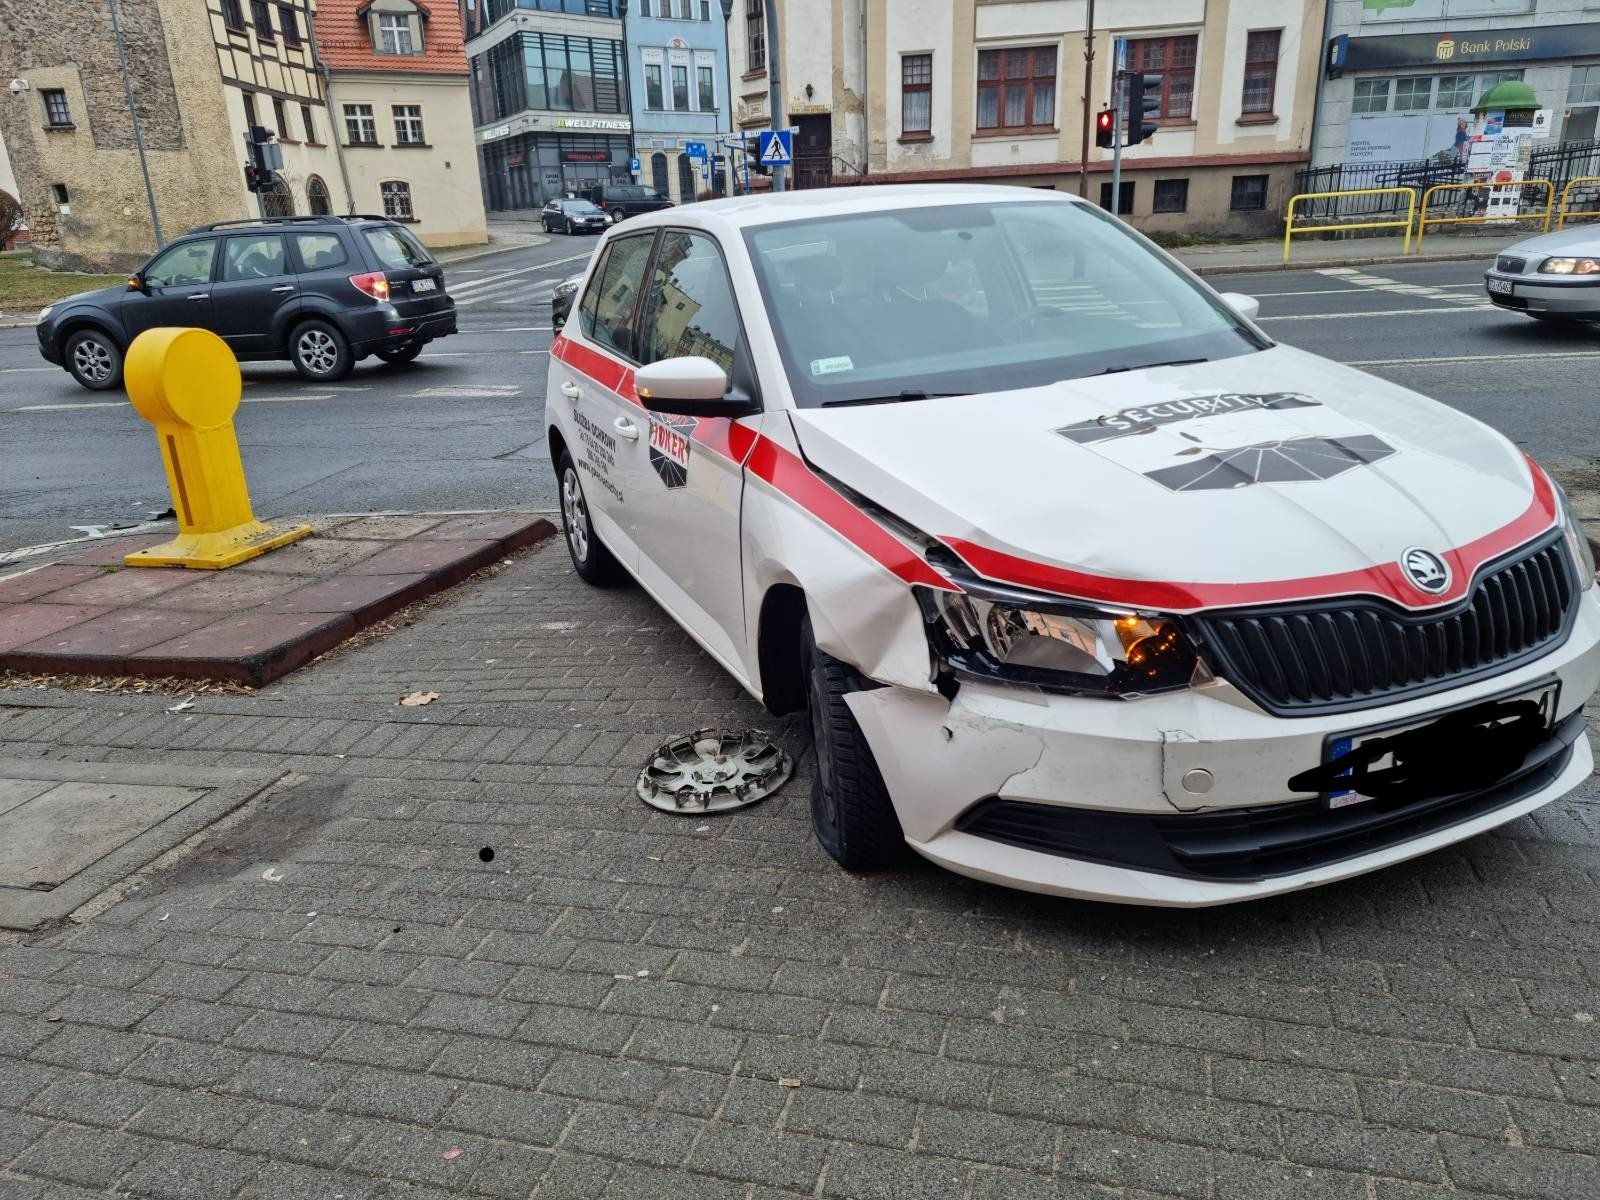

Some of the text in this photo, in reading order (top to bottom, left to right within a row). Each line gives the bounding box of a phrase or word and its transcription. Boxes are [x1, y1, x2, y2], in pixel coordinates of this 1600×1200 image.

[1461, 37, 1531, 53] Bank Polski
[565, 119, 631, 130] WELLFITNESS
[632, 159, 639, 169] P
